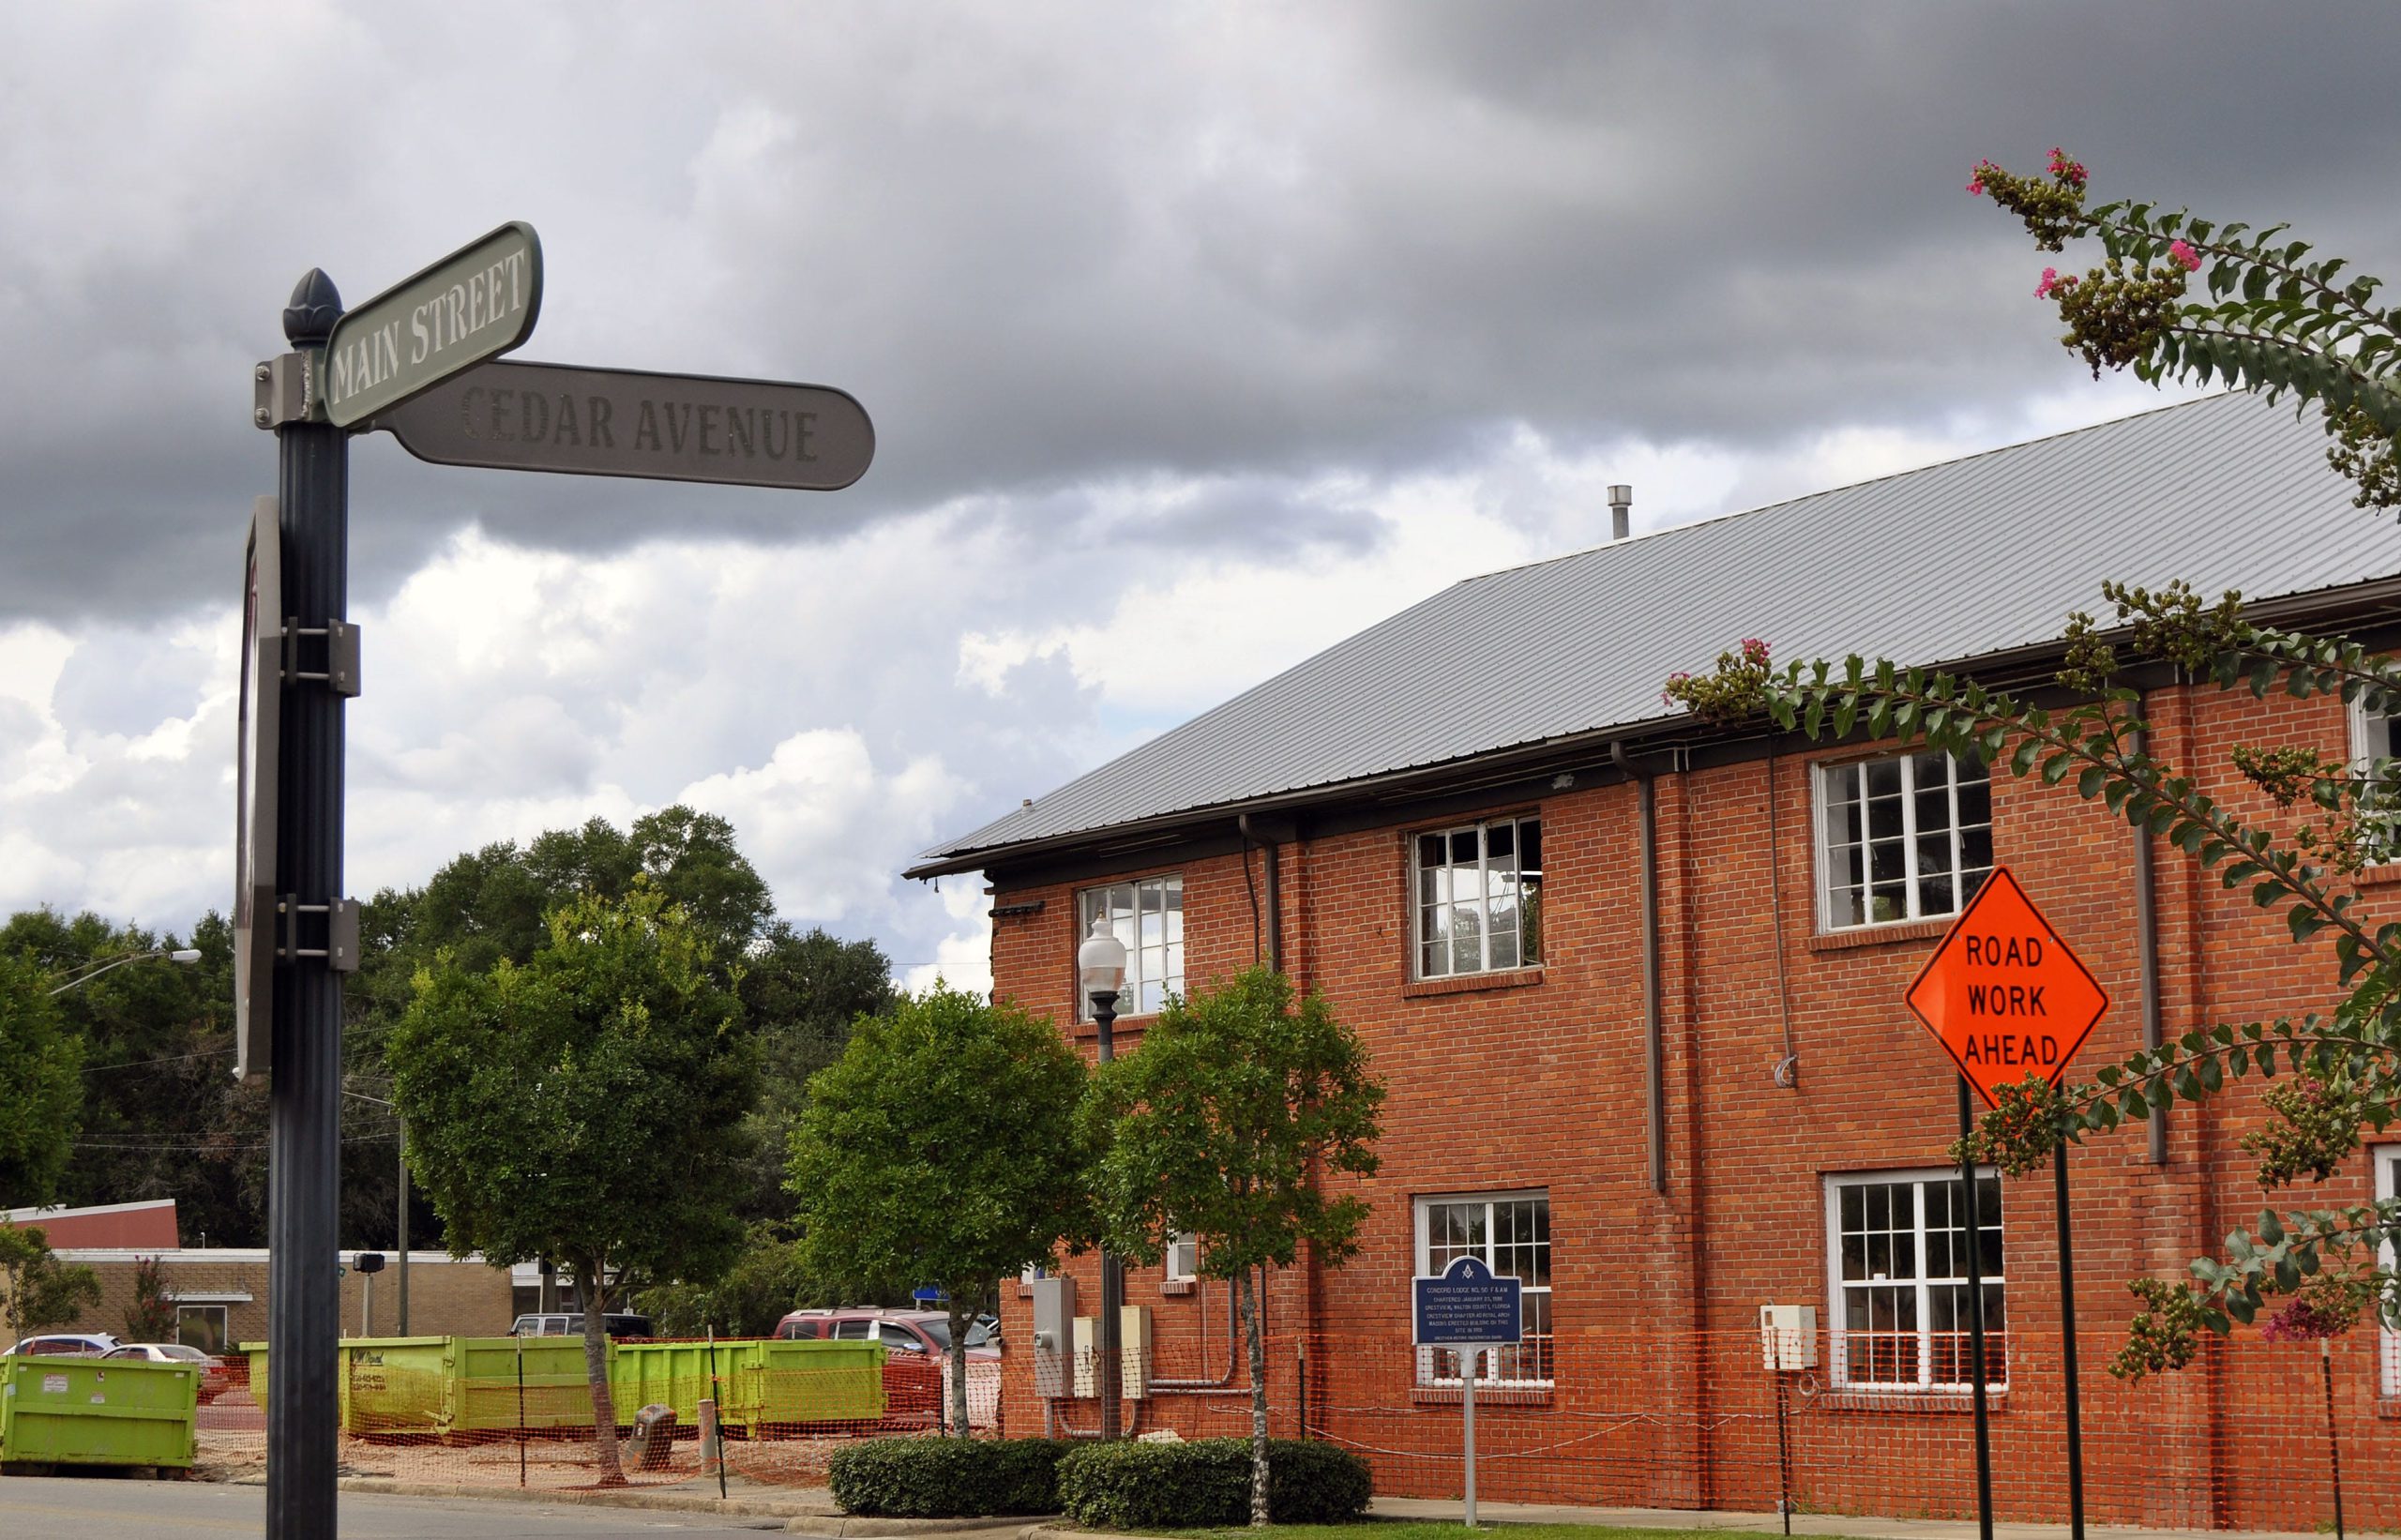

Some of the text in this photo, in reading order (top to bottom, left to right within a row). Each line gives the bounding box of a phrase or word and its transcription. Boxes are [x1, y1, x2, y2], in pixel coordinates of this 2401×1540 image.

[333, 249, 525, 404] MAIN STREET
[462, 385, 819, 462] CEDAR AVENUE
[1966, 935, 2043, 967] ROAD
[1968, 985, 2047, 1017] WORK
[1965, 1034, 2058, 1065] AHEAD
